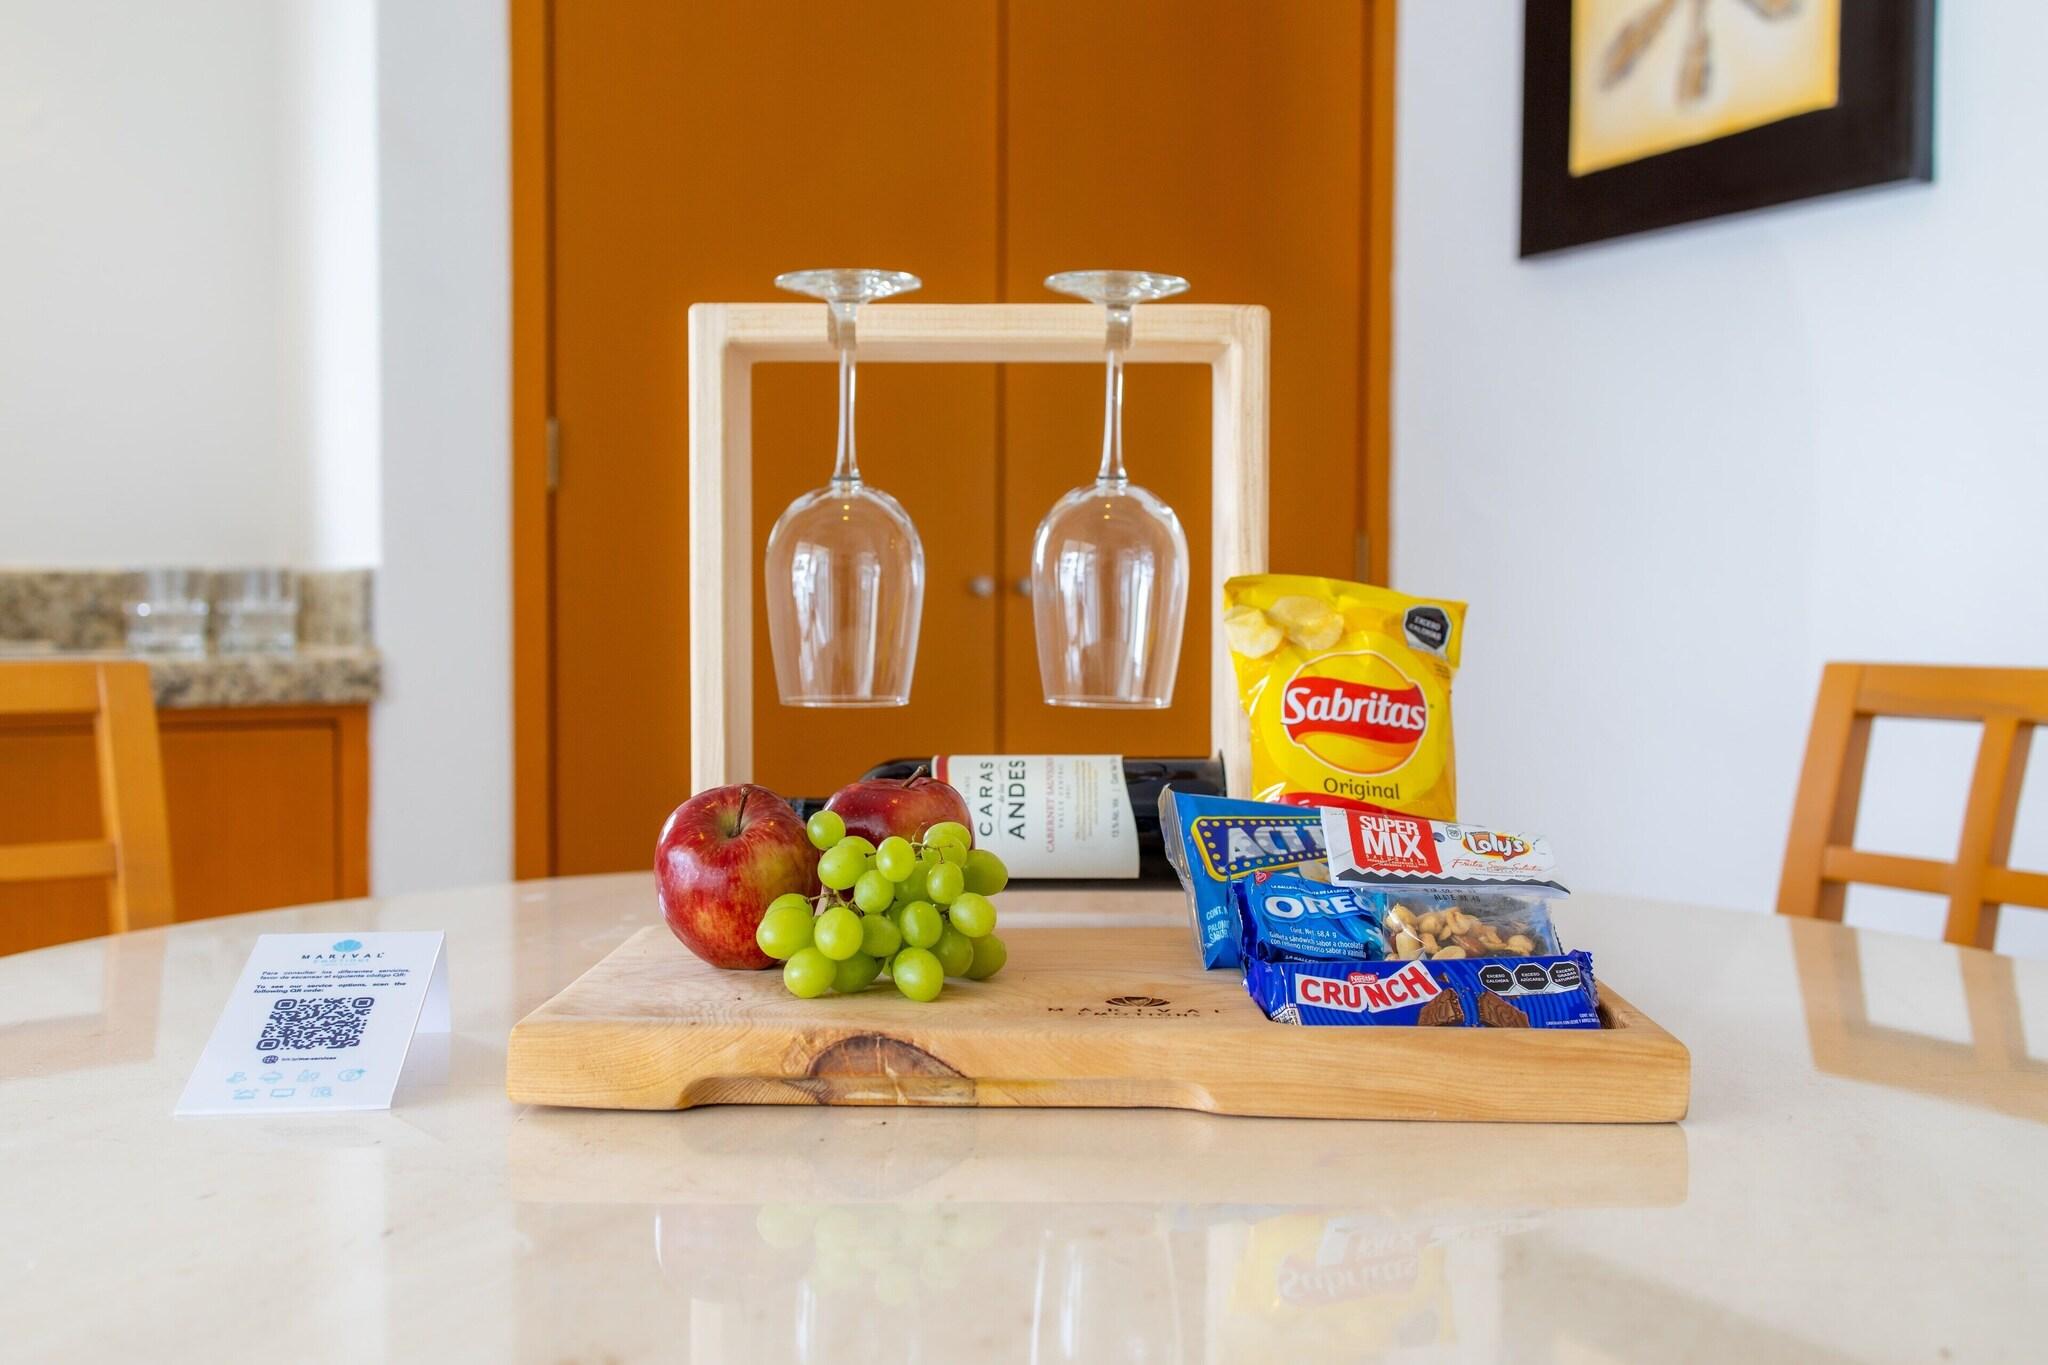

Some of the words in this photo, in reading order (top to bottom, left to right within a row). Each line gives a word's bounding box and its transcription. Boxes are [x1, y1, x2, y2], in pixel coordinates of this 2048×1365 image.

[1282, 687, 1425, 731] Sabritas
[980, 761, 993, 837] CARAS
[1008, 760, 1025, 840] ANDES
[1324, 778, 1400, 800] Original
[1046, 799, 1055, 853] CABERNET
[1359, 815, 1420, 836] SUPER
[1228, 826, 1306, 863] ACT
[1361, 829, 1427, 860] MIX
[1316, 939, 1331, 947] sabor
[1326, 946, 1340, 954] sabor
[1301, 966, 1439, 1008] CRUNCH
